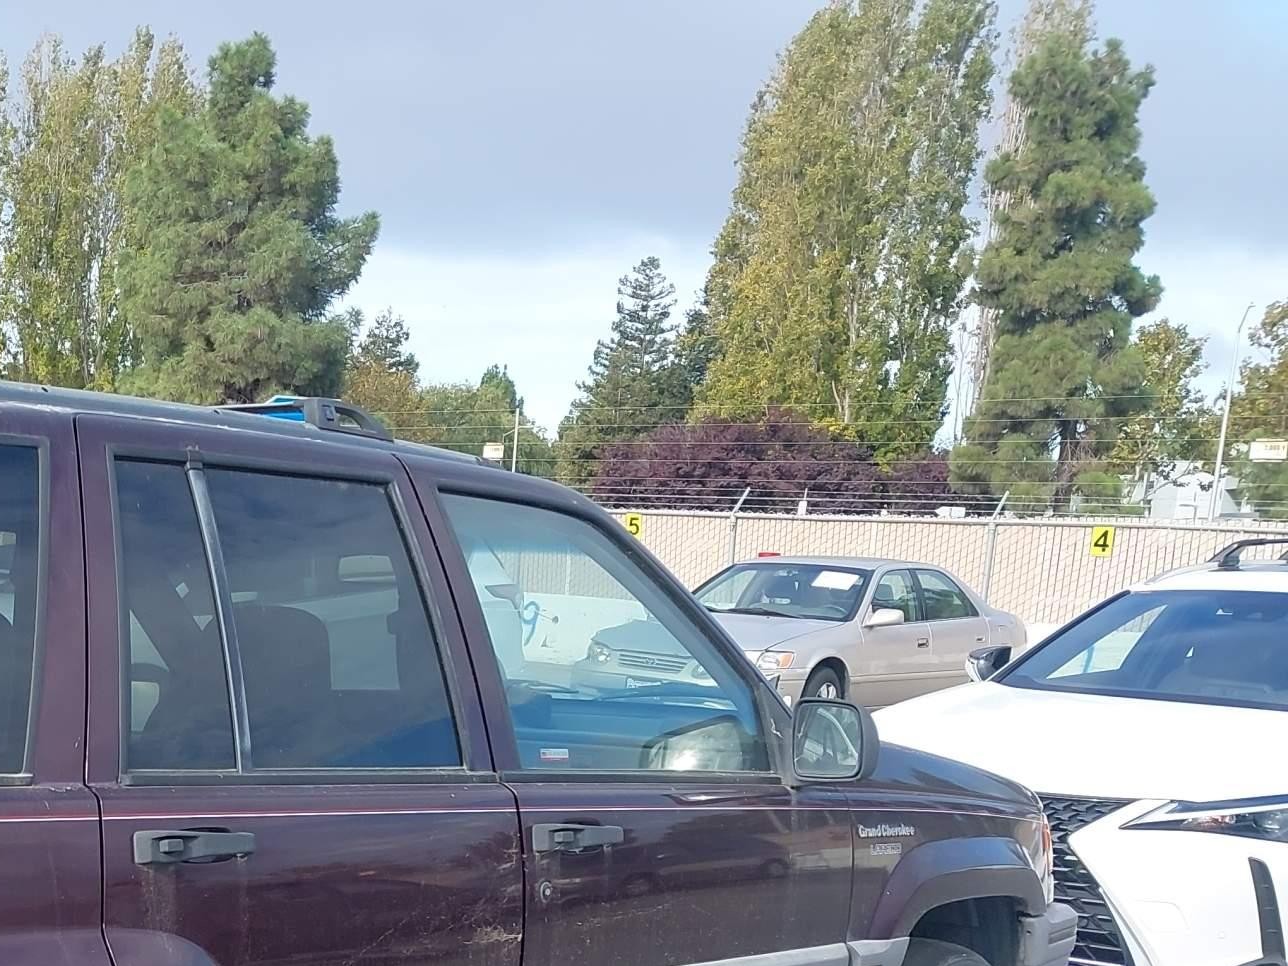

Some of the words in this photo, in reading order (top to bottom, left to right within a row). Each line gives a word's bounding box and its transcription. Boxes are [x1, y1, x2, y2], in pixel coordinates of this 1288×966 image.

[627, 517, 640, 535] 5
[1094, 530, 1110, 552] 4
[858, 823, 881, 839] Grand
[881, 822, 916, 838] Cherokee
